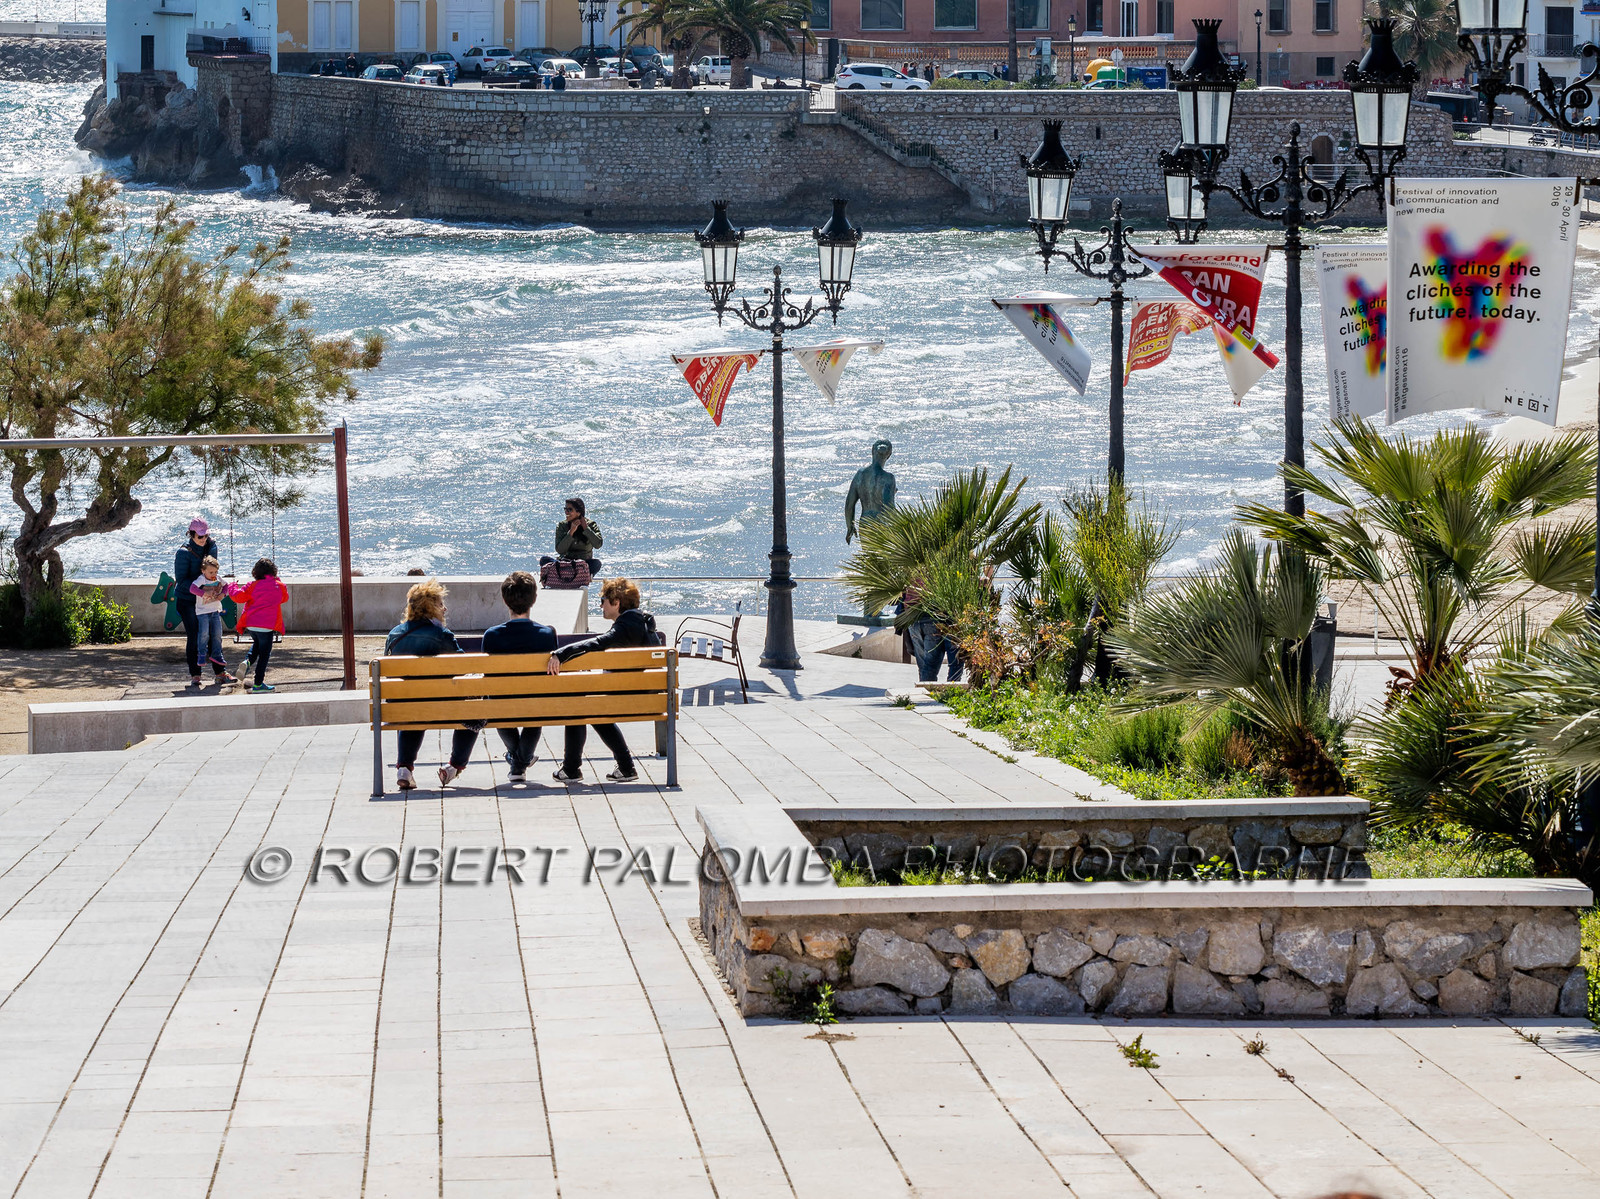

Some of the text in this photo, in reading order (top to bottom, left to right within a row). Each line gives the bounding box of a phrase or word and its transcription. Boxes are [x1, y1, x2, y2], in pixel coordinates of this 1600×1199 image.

[1551, 185, 1561, 206] 2016
[1564, 186, 1574, 196] 29
[1396, 197, 1500, 205] in communication and
[1396, 206, 1445, 216] new media
[1562, 205, 1571, 217] 30
[1559, 219, 1570, 241] April
[1409, 261, 1541, 278] Awarding the
[1406, 282, 1541, 300] clichés of the
[1340, 297, 1387, 318] Awardin
[1409, 304, 1540, 323] future, today.
[1401, 347, 1409, 410] #sitgesnext16
[1504, 394, 1549, 413] NEXT
